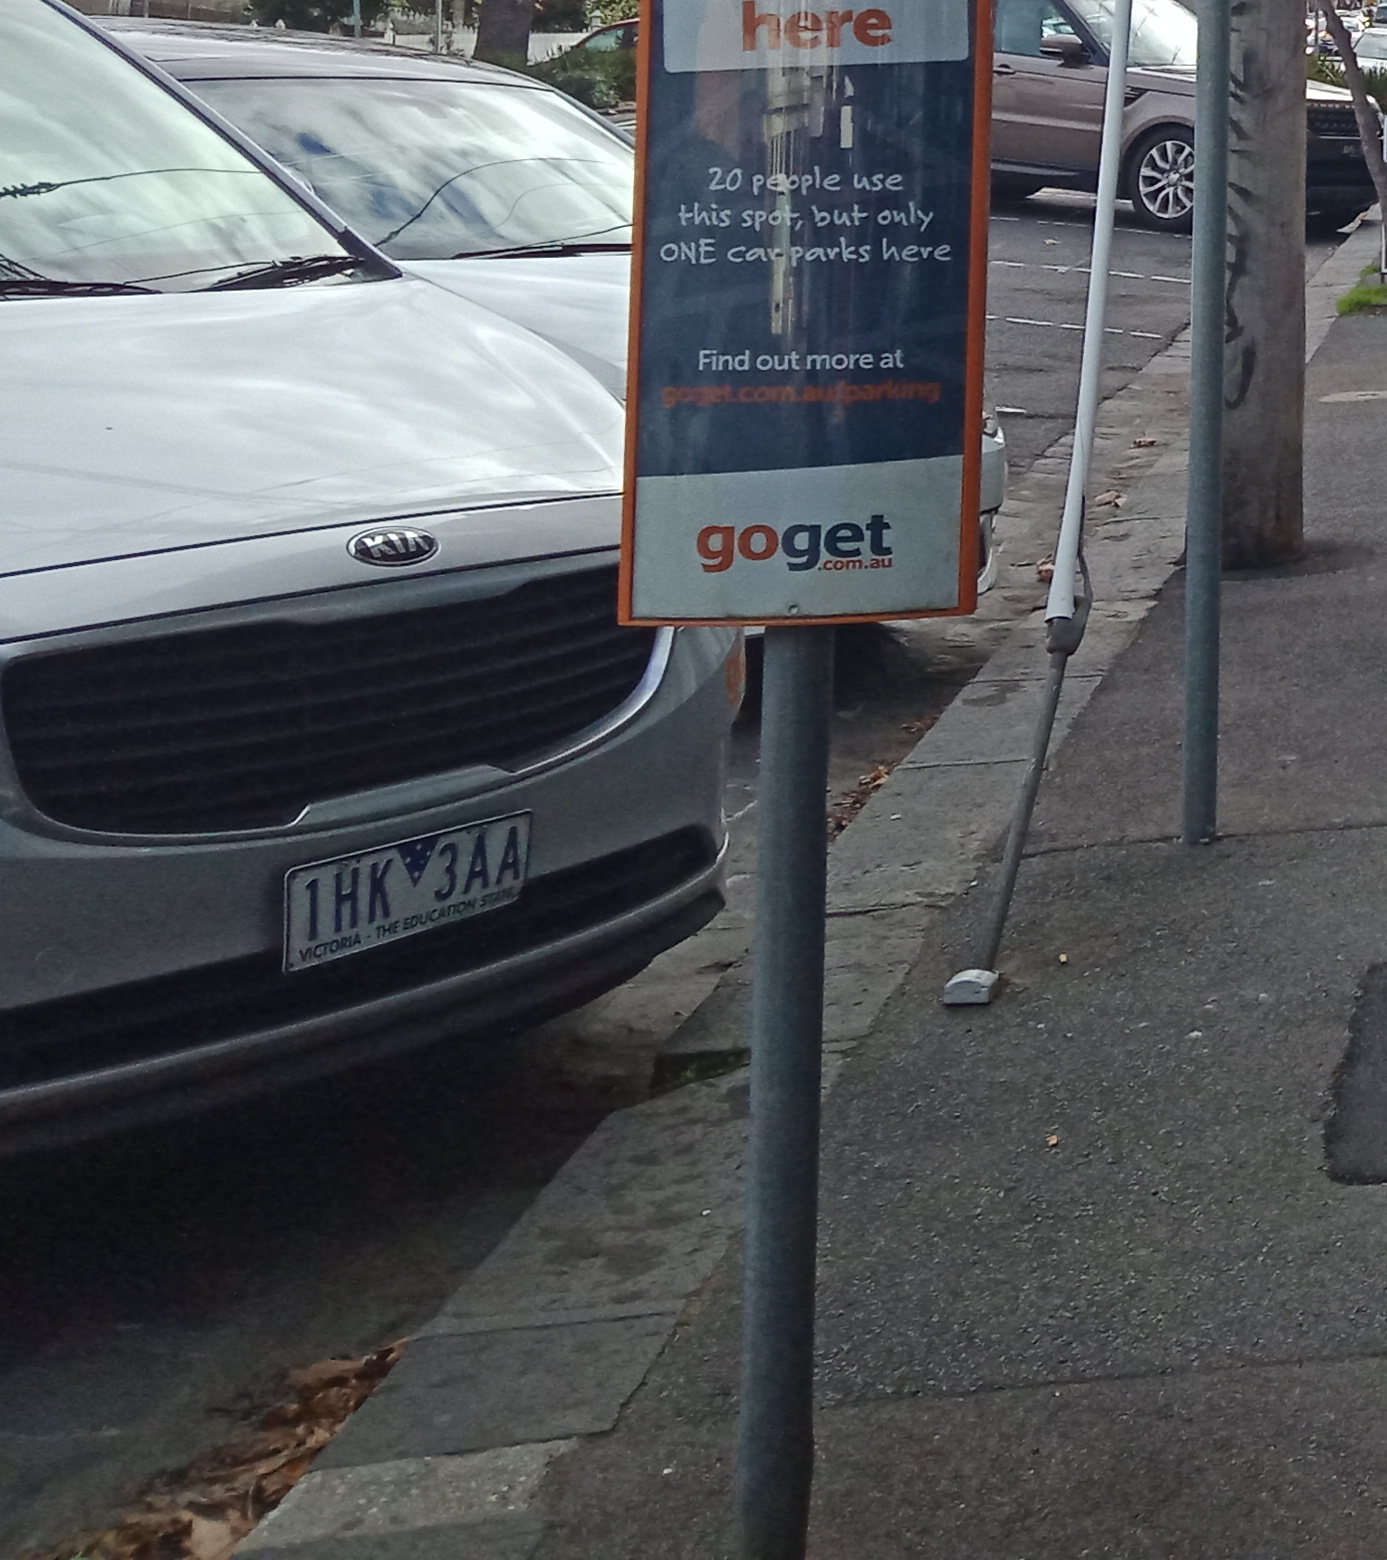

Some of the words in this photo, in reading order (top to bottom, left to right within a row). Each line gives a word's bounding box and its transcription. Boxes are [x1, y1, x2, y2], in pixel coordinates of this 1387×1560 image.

[742, 0, 893, 52] here
[708, 167, 743, 191] 20
[752, 166, 841, 195] people
[853, 172, 903, 191] use
[678, 203, 732, 227] this
[741, 208, 803, 231] spot,
[811, 205, 868, 227] but
[877, 201, 933, 231] only
[660, 238, 716, 264] ONE
[727, 245, 782, 262] car
[789, 237, 871, 267] parks
[882, 238, 951, 262] here
[698, 349, 750, 370] Find
[756, 351, 799, 370] out
[806, 352, 874, 369] more
[880, 349, 904, 368] at
[360, 531, 430, 558] KIA
[697, 514, 893, 573] goget
[305, 858, 394, 942] 1HK
[434, 825, 520, 901] 3AA
[299, 933, 361, 962] VICTORIA
[375, 920, 400, 939] THE
[403, 901, 475, 931] EDUCATION
